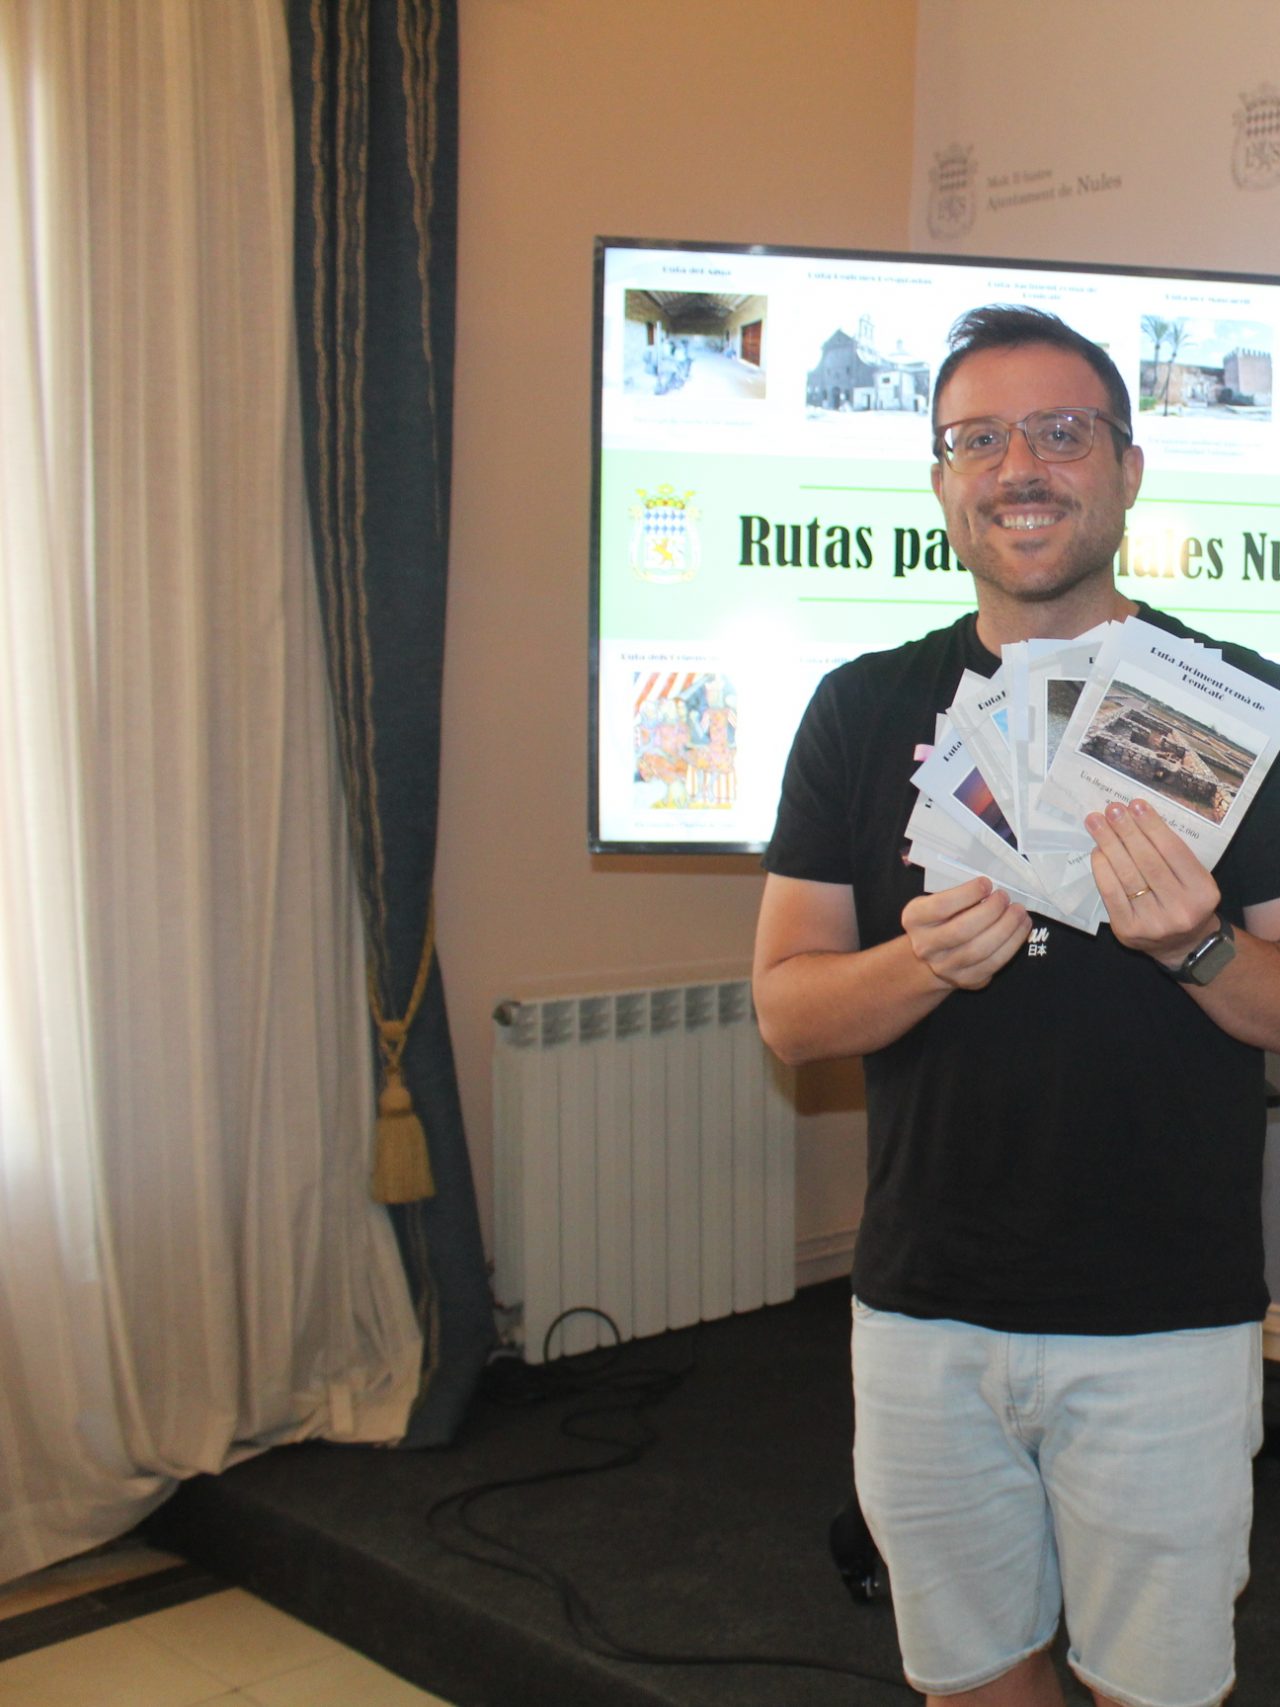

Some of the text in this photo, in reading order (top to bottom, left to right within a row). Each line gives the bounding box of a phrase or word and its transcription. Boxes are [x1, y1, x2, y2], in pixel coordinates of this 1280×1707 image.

[1077, 171, 1122, 195] Nules
[738, 513, 873, 570] Rutas
[1027, 943, 1047, 957] 日本
